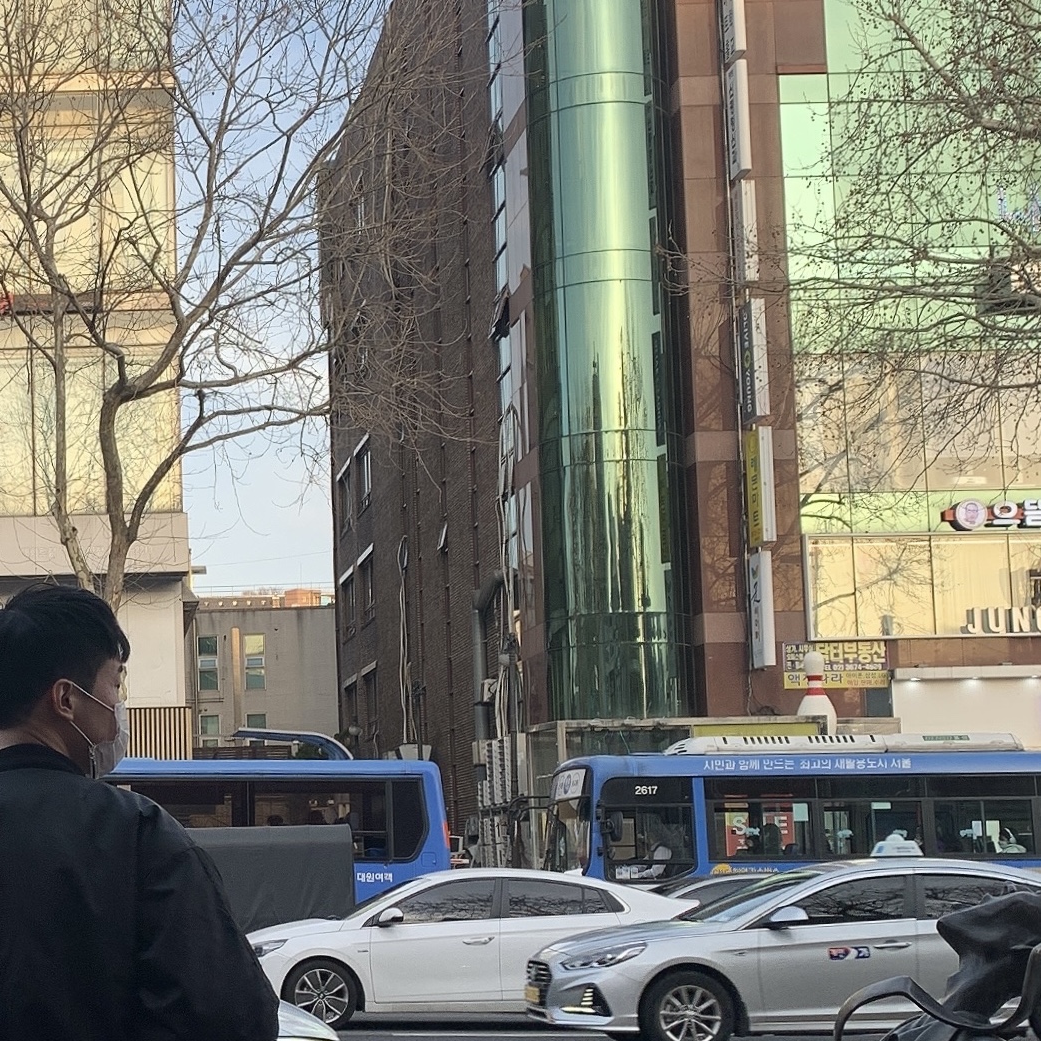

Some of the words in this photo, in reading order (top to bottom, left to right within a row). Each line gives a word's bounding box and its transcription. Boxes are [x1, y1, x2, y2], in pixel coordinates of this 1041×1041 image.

[742, 308, 750, 349] OLIVE
[703, 759, 736, 771] 시민과
[763, 758, 795, 770] 만드는
[634, 785, 659, 795] 2617
[356, 872, 393, 883] 대원여객
